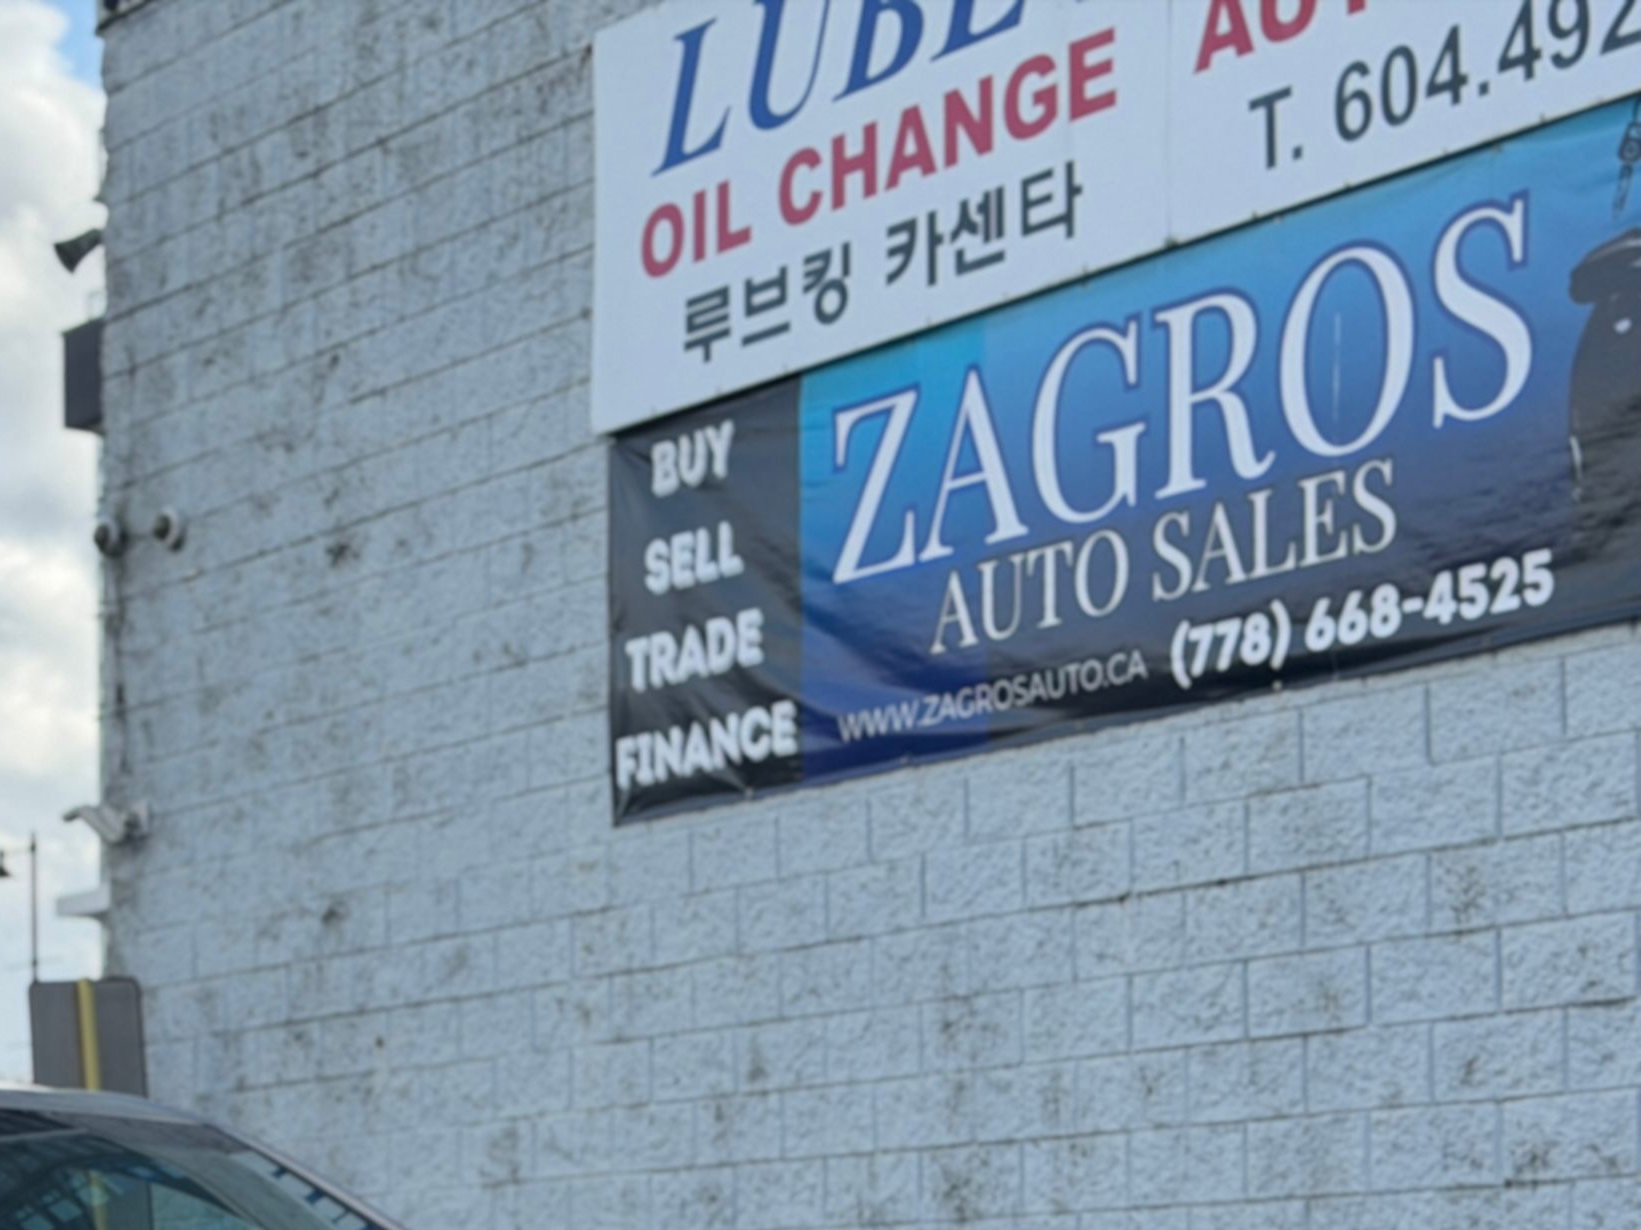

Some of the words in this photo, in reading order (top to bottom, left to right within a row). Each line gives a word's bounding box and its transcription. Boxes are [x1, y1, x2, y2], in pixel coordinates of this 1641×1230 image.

[641, 180, 752, 278] OIL
[778, 27, 1118, 226] CHANGE
[1194, 0, 1370, 74] AU
[1249, 87, 1303, 169] T.
[683, 241, 852, 363] 루브킹
[885, 160, 1083, 286] 카센타
[831, 194, 1534, 585] ZAGROS
[650, 420, 734, 497] BUY
[644, 521, 743, 595] SELL
[930, 529, 1129, 656] AUTO
[1152, 457, 1396, 602] SALES
[625, 607, 765, 693] TRADE
[1170, 598, 1291, 689] (778)
[1305, 548, 1554, 652] 668-4525
[837, 649, 1148, 743] WWW.ZAGROSAUTO.CA
[615, 701, 798, 790] FINANCE
